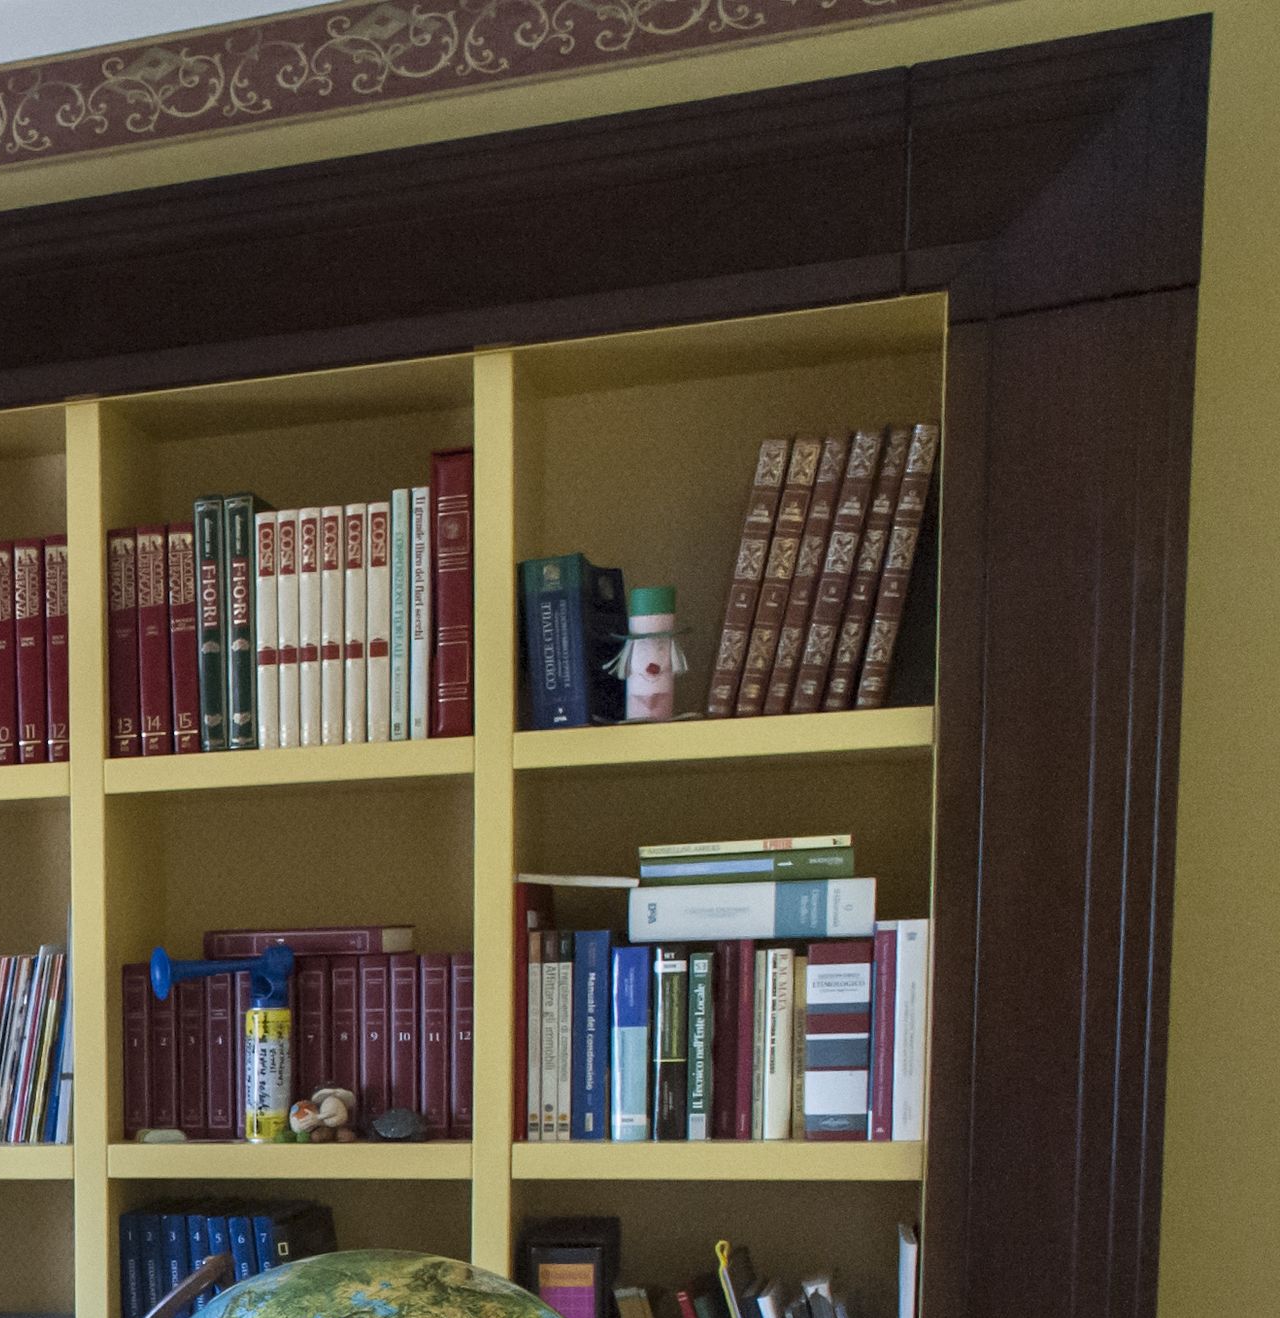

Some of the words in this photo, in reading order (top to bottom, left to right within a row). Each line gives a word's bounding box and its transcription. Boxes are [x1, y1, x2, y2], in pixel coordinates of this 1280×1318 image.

[414, 507, 425, 541] grande
[415, 543, 424, 566] libro
[414, 608, 423, 641] secchi
[541, 602, 553, 643] CIVILE
[545, 644, 557, 690] CODICE
[117, 719, 132, 734] 13
[147, 716, 161, 731] 14
[178, 713, 192, 728] 15
[25, 724, 36, 739] 11
[51, 723, 66, 738] 12
[545, 965, 555, 1006] Affittare
[587, 972, 596, 1013] Manuale
[694, 983, 705, 1015] Locale
[587, 1016, 595, 1031] del
[133, 1037, 138, 1047] 1
[160, 1037, 167, 1047] 2
[216, 1036, 222, 1046] 4
[341, 1032, 348, 1041] 8
[370, 1032, 378, 1041] 9
[398, 1032, 411, 1042] 10
[429, 1032, 440, 1043] 11
[458, 1031, 471, 1040] 12
[694, 1017, 704, 1059] nell'Ente
[545, 1027, 555, 1070] immobili
[586, 1033, 594, 1090] condominio
[693, 1061, 703, 1097] Tecnico
[127, 1231, 132, 1241] 1
[146, 1231, 152, 1241] 2
[170, 1231, 176, 1241] 3
[193, 1232, 200, 1242] 4
[215, 1234, 222, 1243] 5
[238, 1235, 245, 1244] 6
[260, 1233, 267, 1243] 7
